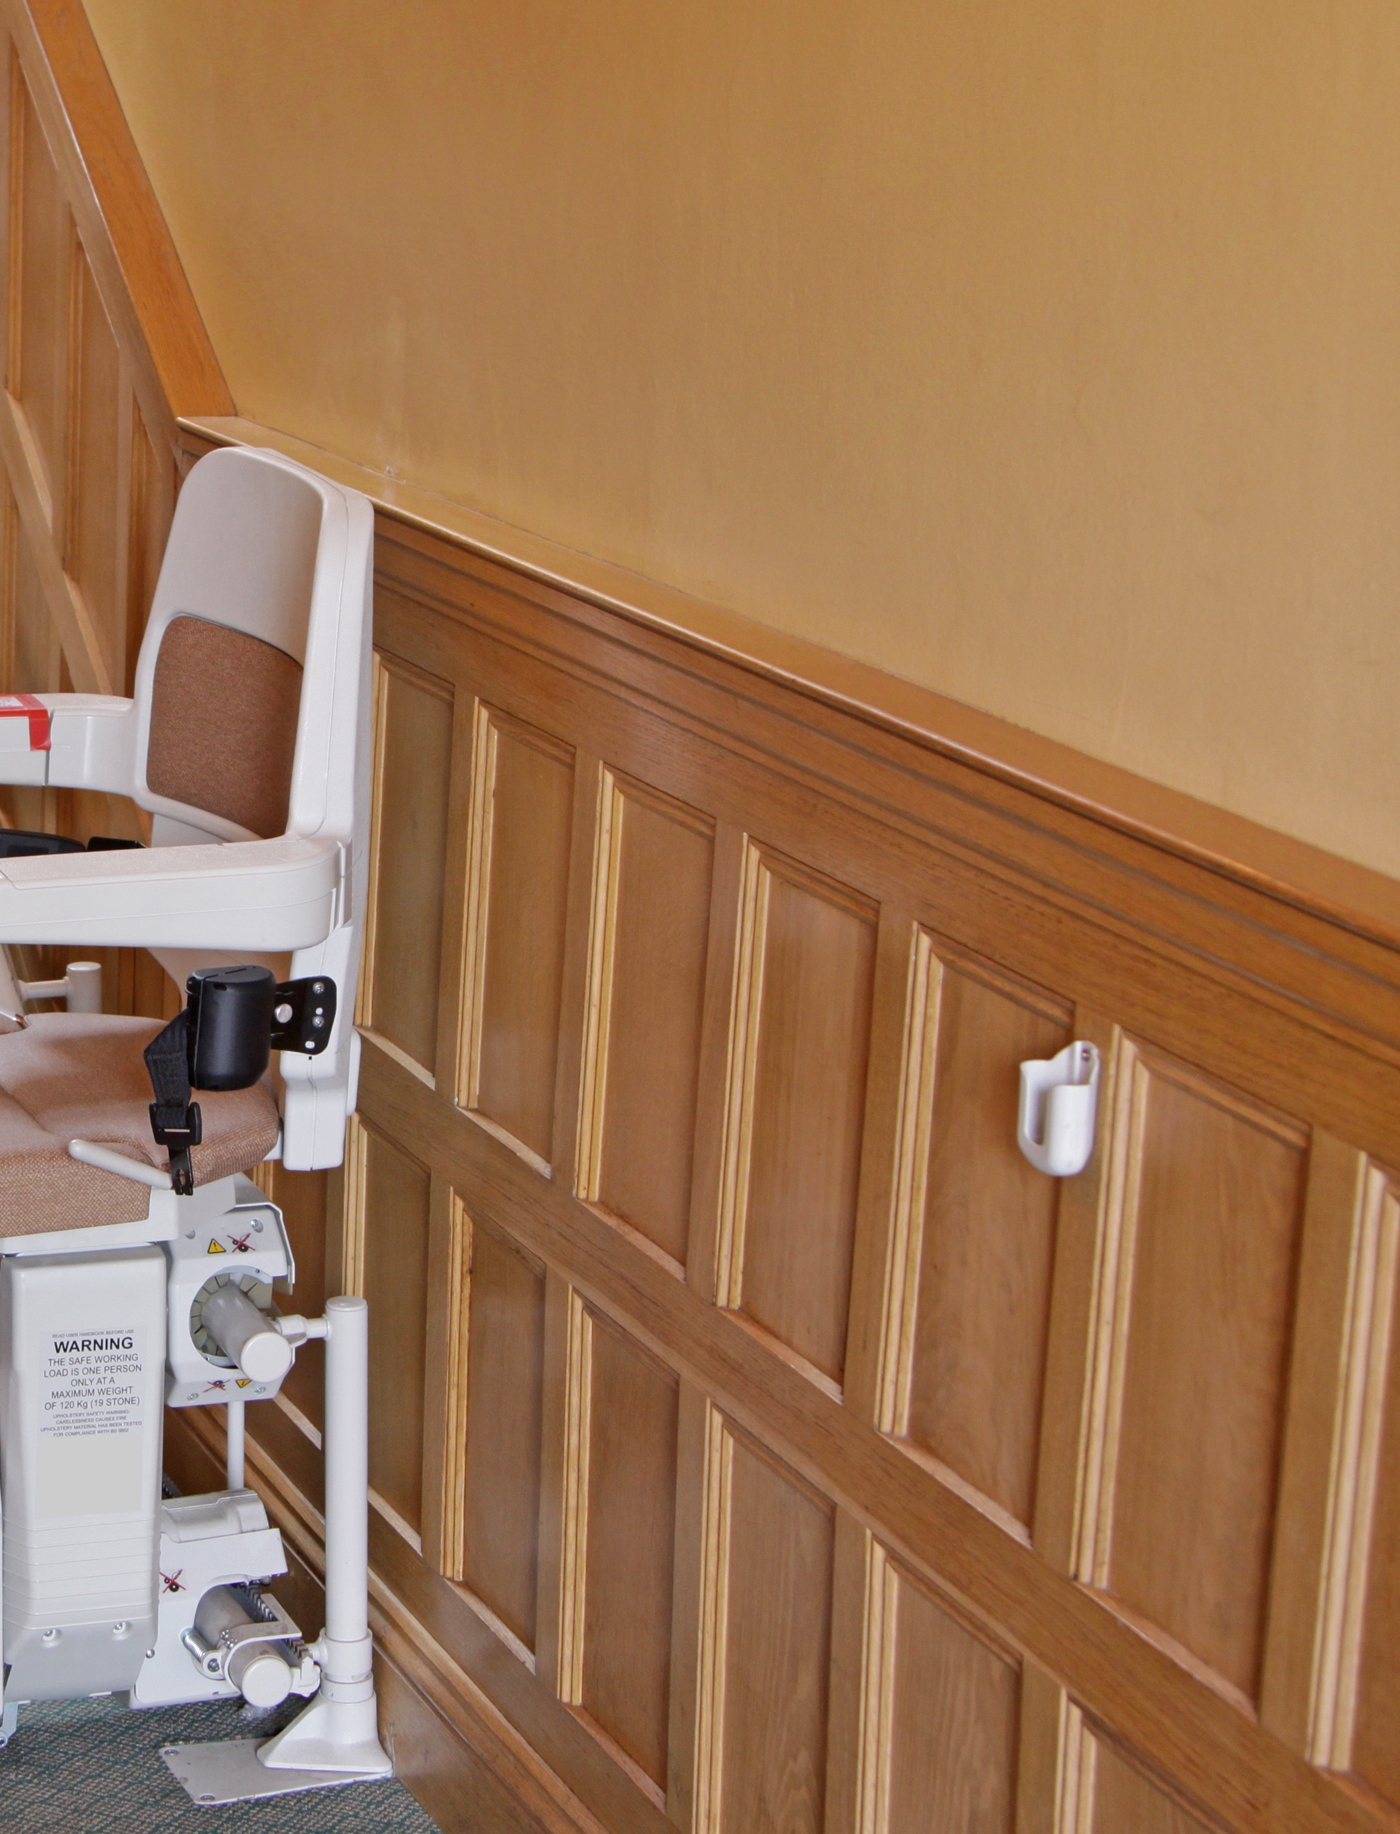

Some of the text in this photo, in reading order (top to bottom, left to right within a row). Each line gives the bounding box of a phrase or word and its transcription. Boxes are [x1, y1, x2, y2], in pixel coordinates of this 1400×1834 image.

[54, 1337, 133, 1353] WARNING
[48, 1353, 138, 1366] THE SAFE WORKING
[44, 1364, 142, 1378] LOAD IS ONE PERSON
[71, 1378, 95, 1387] ONLY
[96, 1377, 107, 1385] AT
[52, 1386, 133, 1399] MAXIMUM WEIGHT
[45, 1397, 140, 1410] OF 120 Kg (19 STONE)
